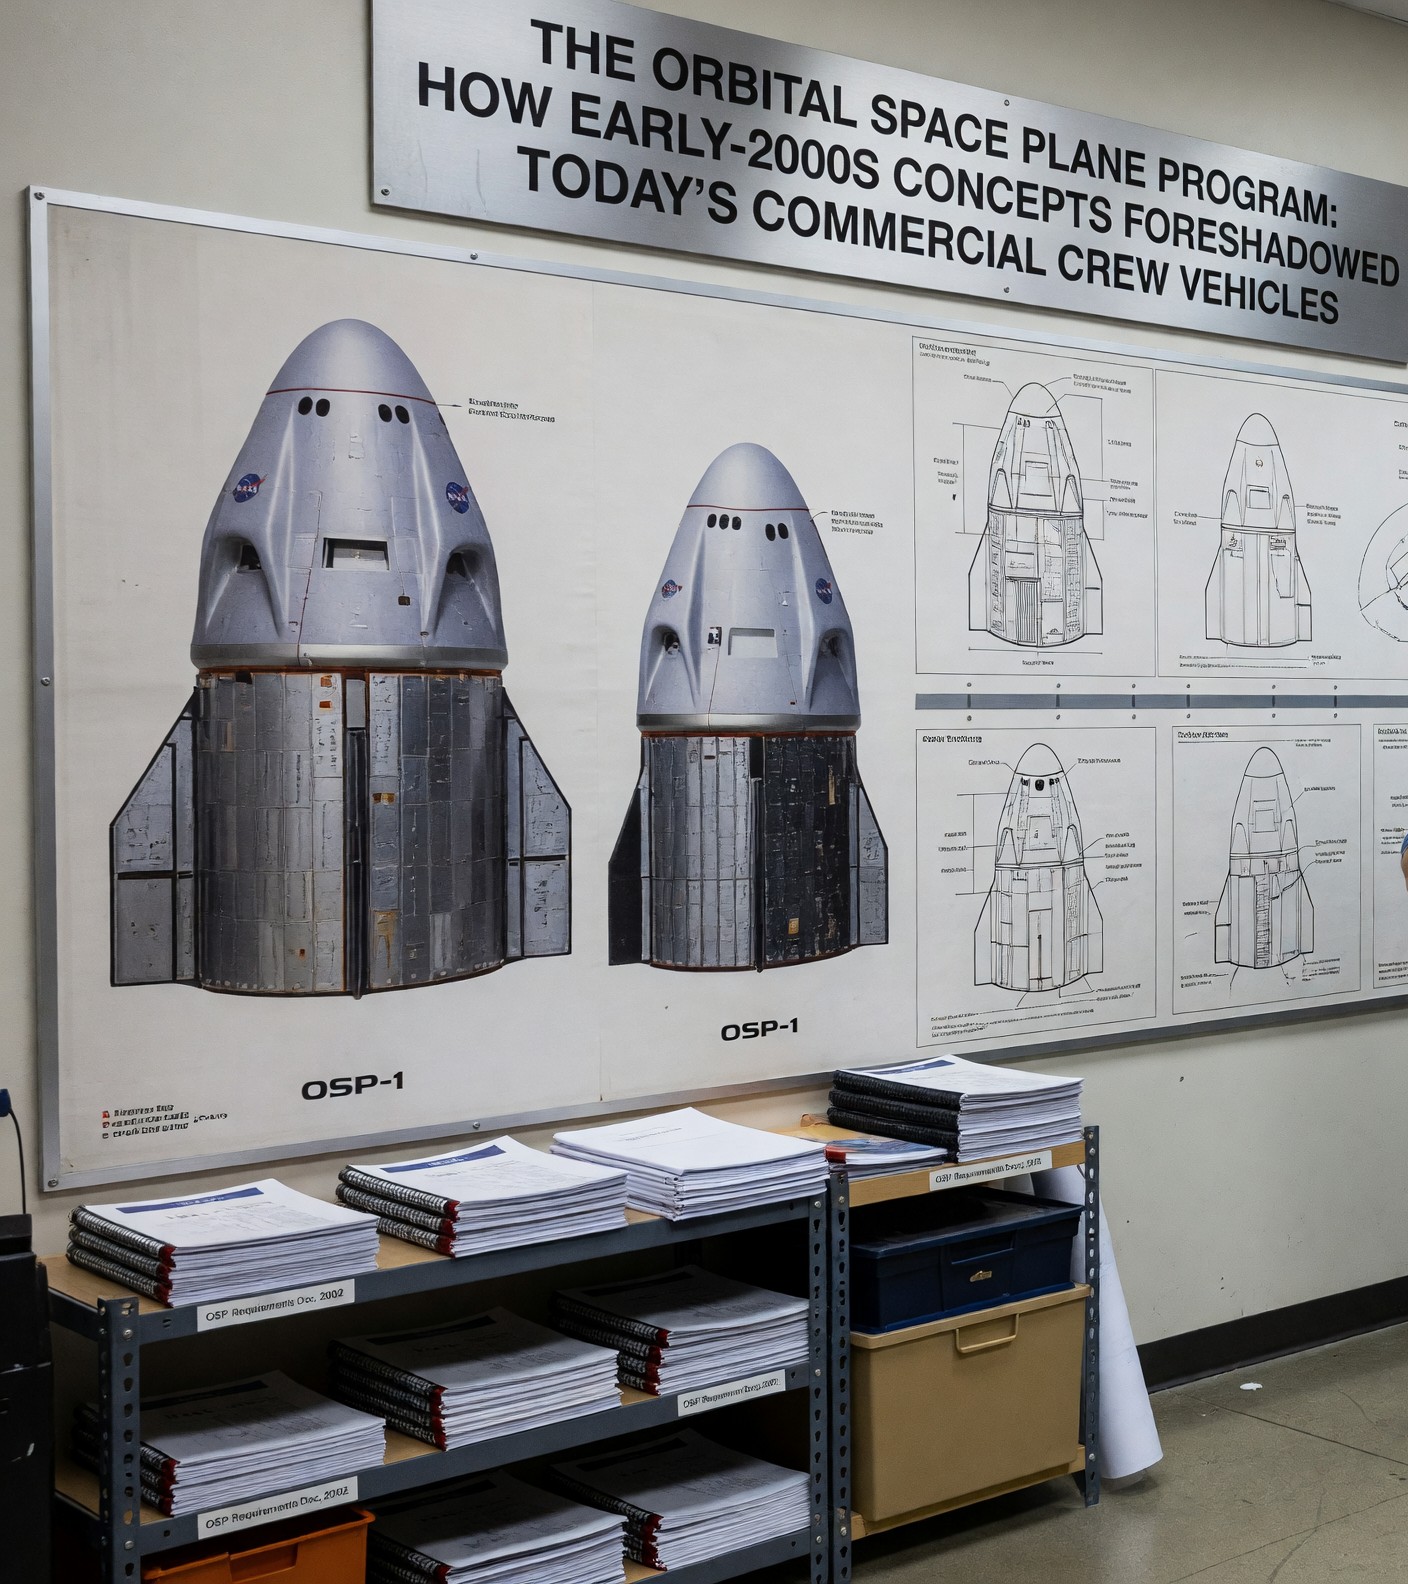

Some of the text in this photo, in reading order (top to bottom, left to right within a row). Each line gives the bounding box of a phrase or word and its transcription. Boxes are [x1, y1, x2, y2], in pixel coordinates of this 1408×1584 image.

[530, 19, 1337, 228] THE ORBITAL SPACE PLANE PROGRAM:
[418, 61, 1400, 288] HOW EARLY-2000S CONCEPTS FORESHADOWED
[517, 145, 1339, 325] TODAY’S COMMERCIAL CREW VEHICLES
[720, 1017, 798, 1042] OSP-1
[301, 1071, 403, 1100] OSP-1
[205, 1309, 229, 1322] OSP
[205, 1516, 229, 1529] OSP
